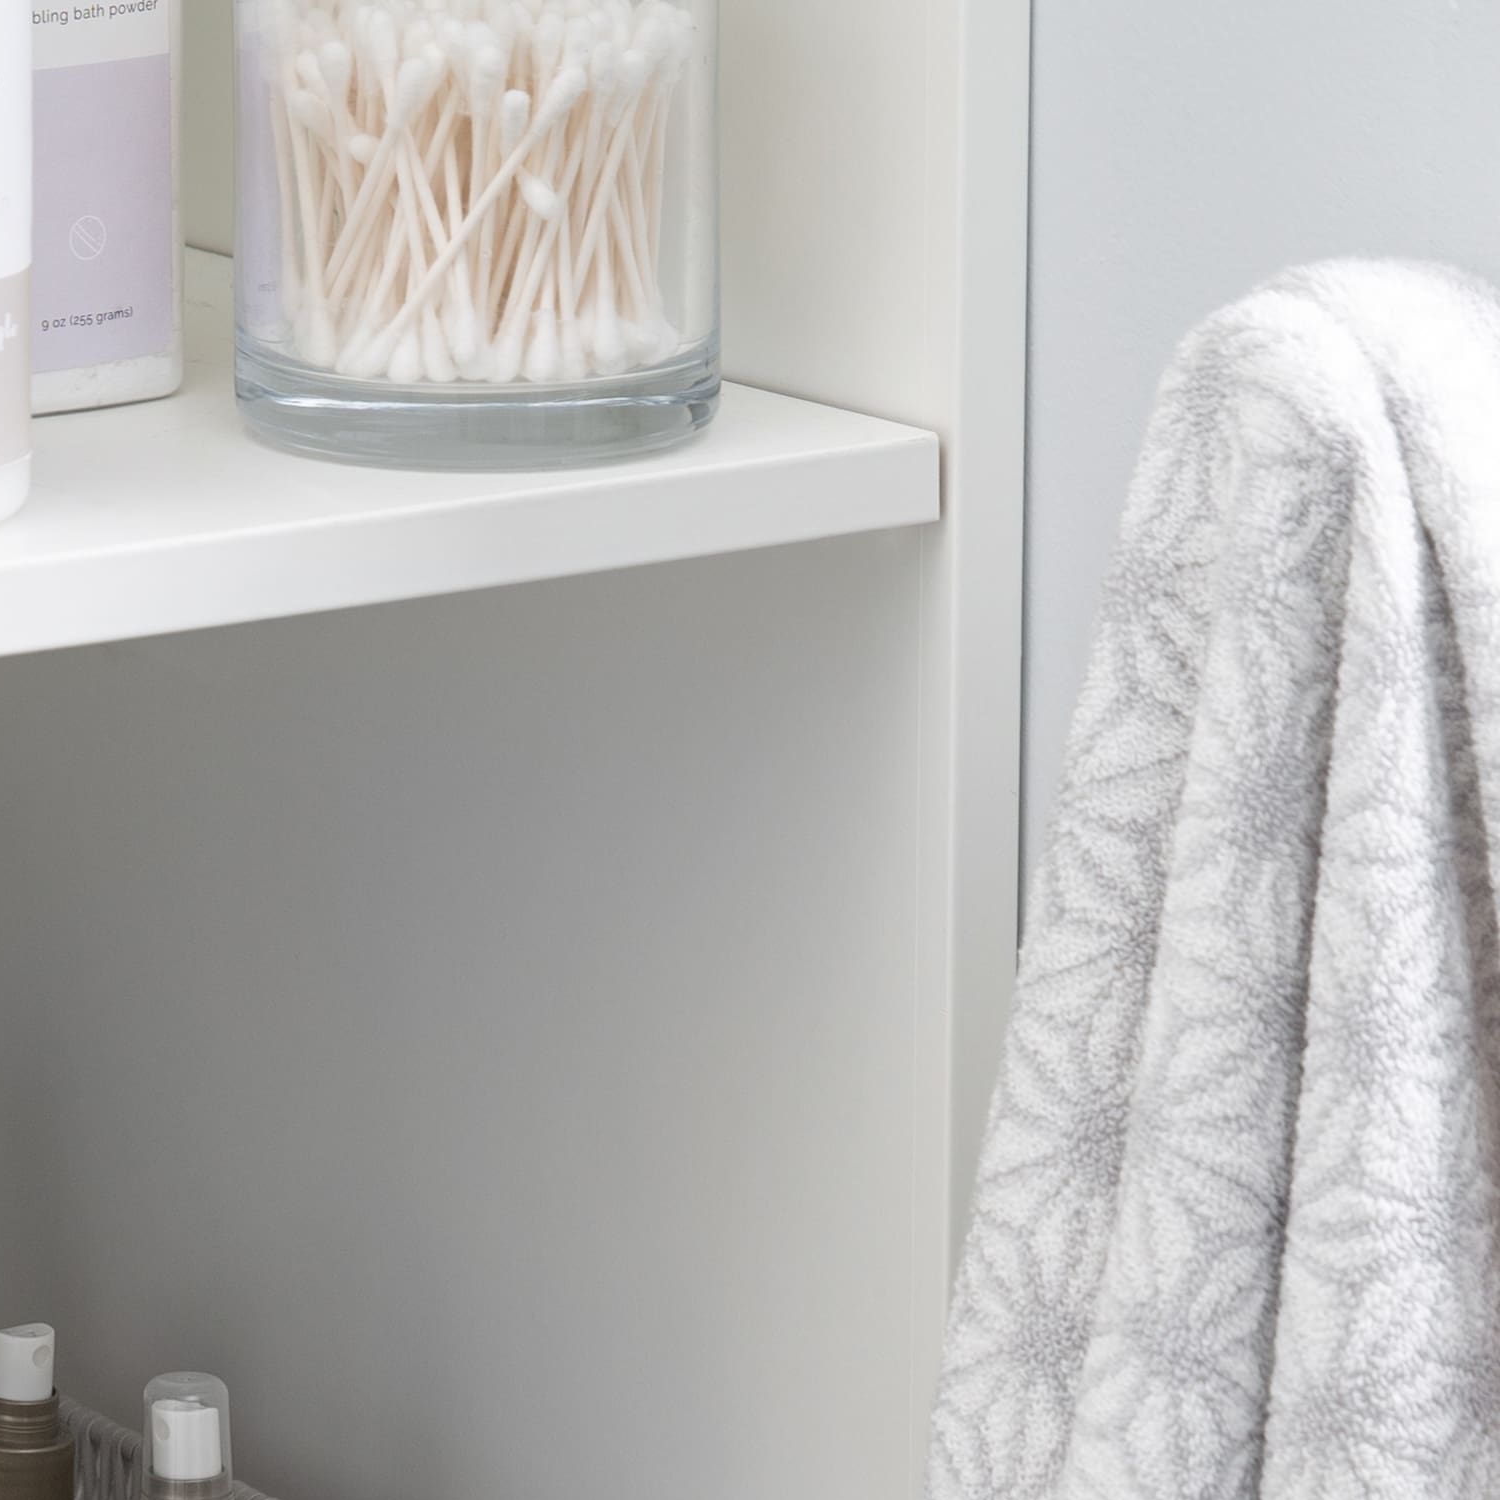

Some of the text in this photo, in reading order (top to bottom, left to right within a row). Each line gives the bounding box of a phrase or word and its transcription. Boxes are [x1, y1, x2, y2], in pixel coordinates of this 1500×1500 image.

[32, 0, 158, 25] bling bath powder
[41, 306, 133, 331] 9 oz (255 grams)
